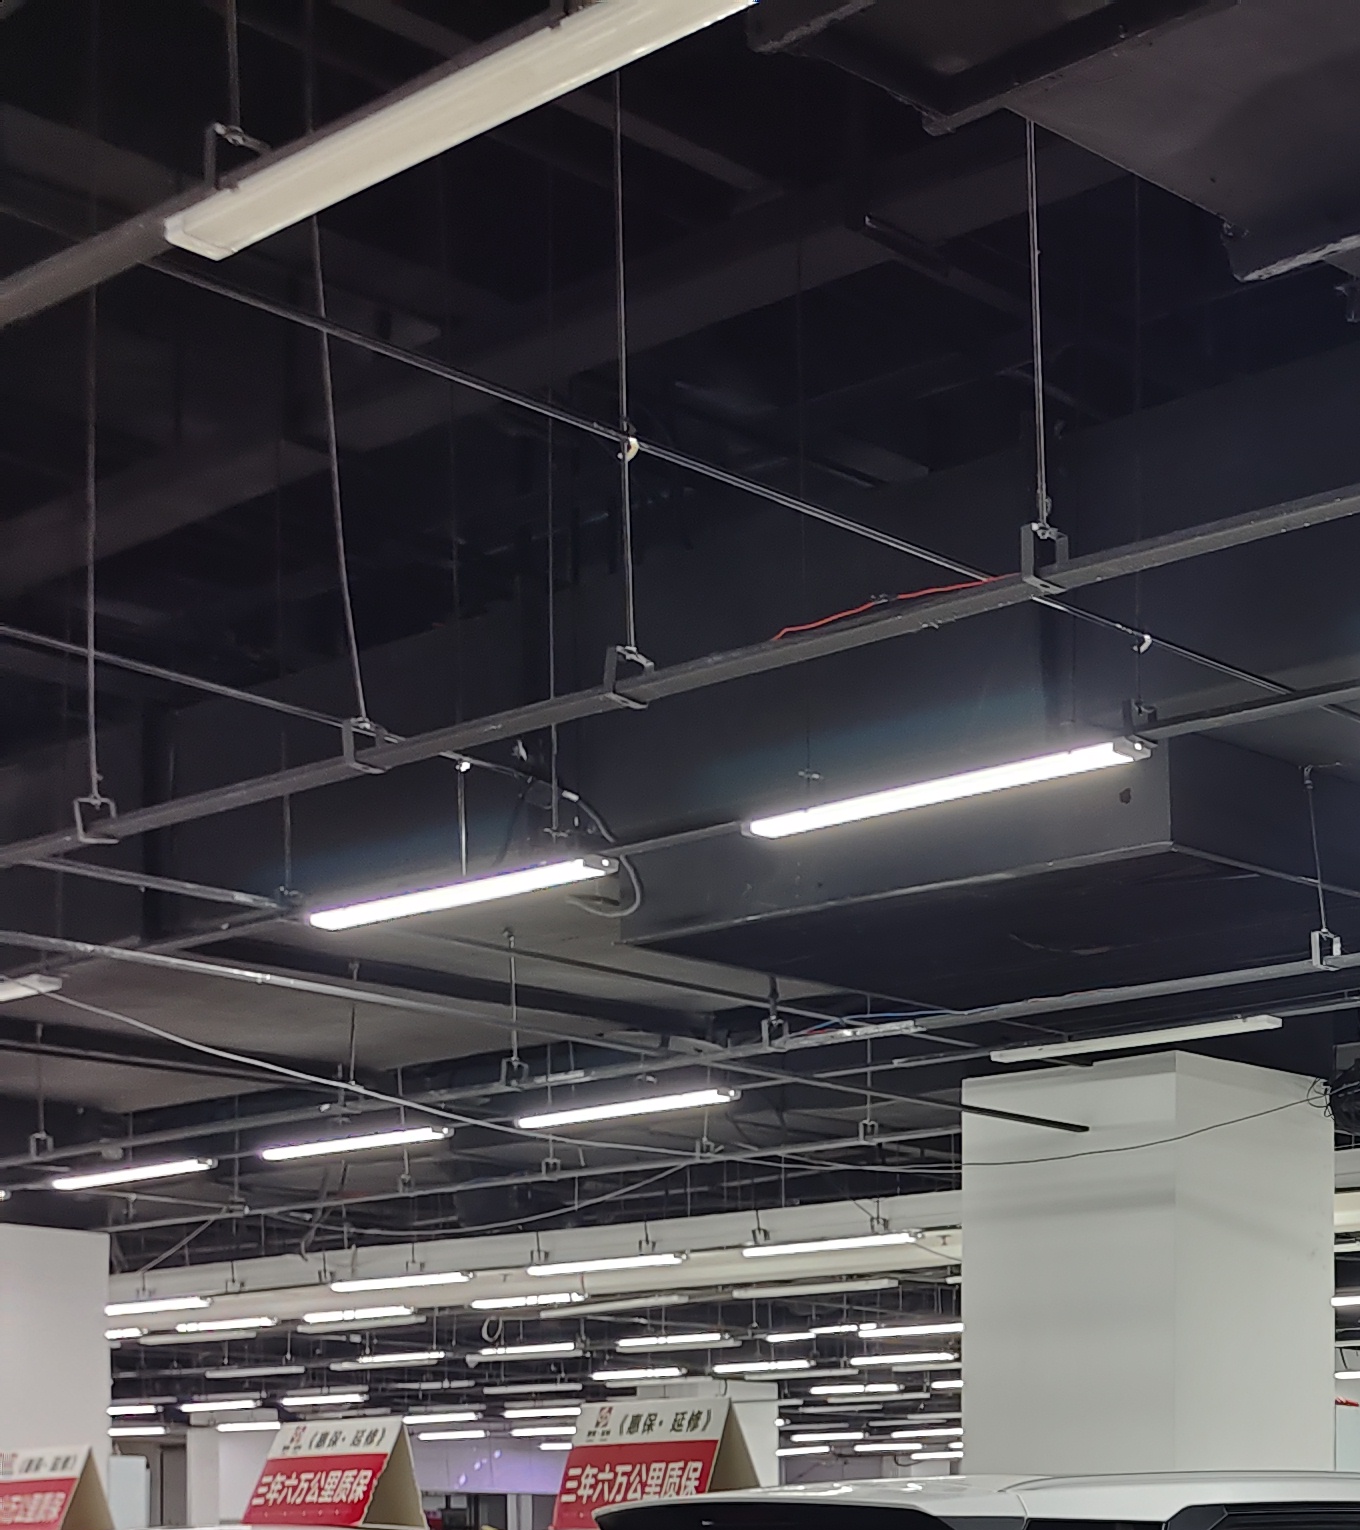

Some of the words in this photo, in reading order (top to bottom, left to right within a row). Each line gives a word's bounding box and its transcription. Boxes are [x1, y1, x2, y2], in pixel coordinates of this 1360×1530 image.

[252, 1469, 373, 1506] 三年六万公里质保
[561, 1460, 703, 1504] 三年六万公里质保
